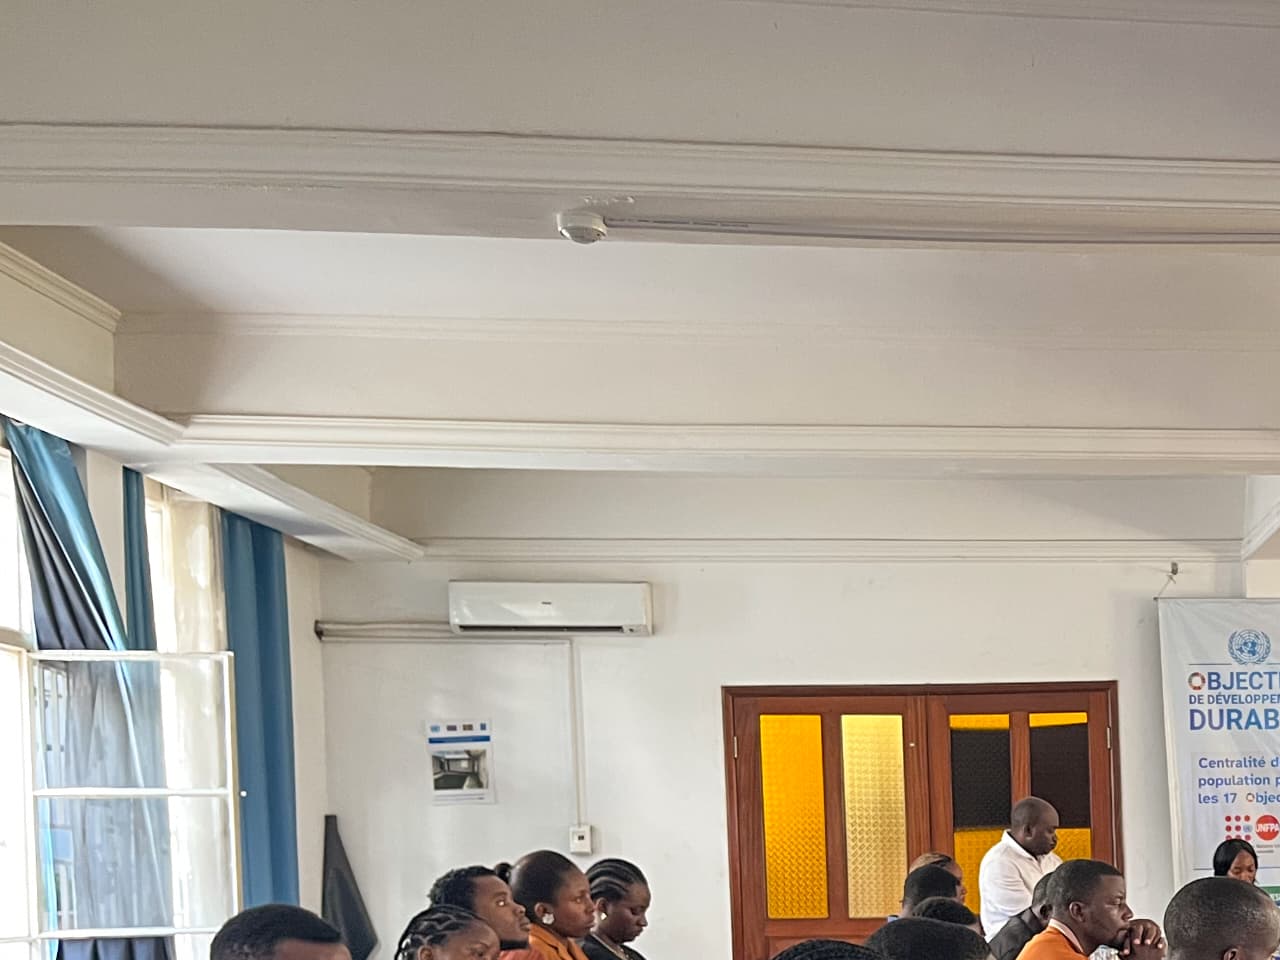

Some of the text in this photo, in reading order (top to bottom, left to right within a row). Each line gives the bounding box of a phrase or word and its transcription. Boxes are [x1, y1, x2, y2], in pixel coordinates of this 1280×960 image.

[1189, 694, 1204, 704] DE
[1198, 756, 1266, 768] Centralité
[1198, 773, 1270, 788] population
[1198, 794, 1218, 804] les
[1224, 793, 1238, 804] 17
[1256, 824, 1280, 832] UNFPA
